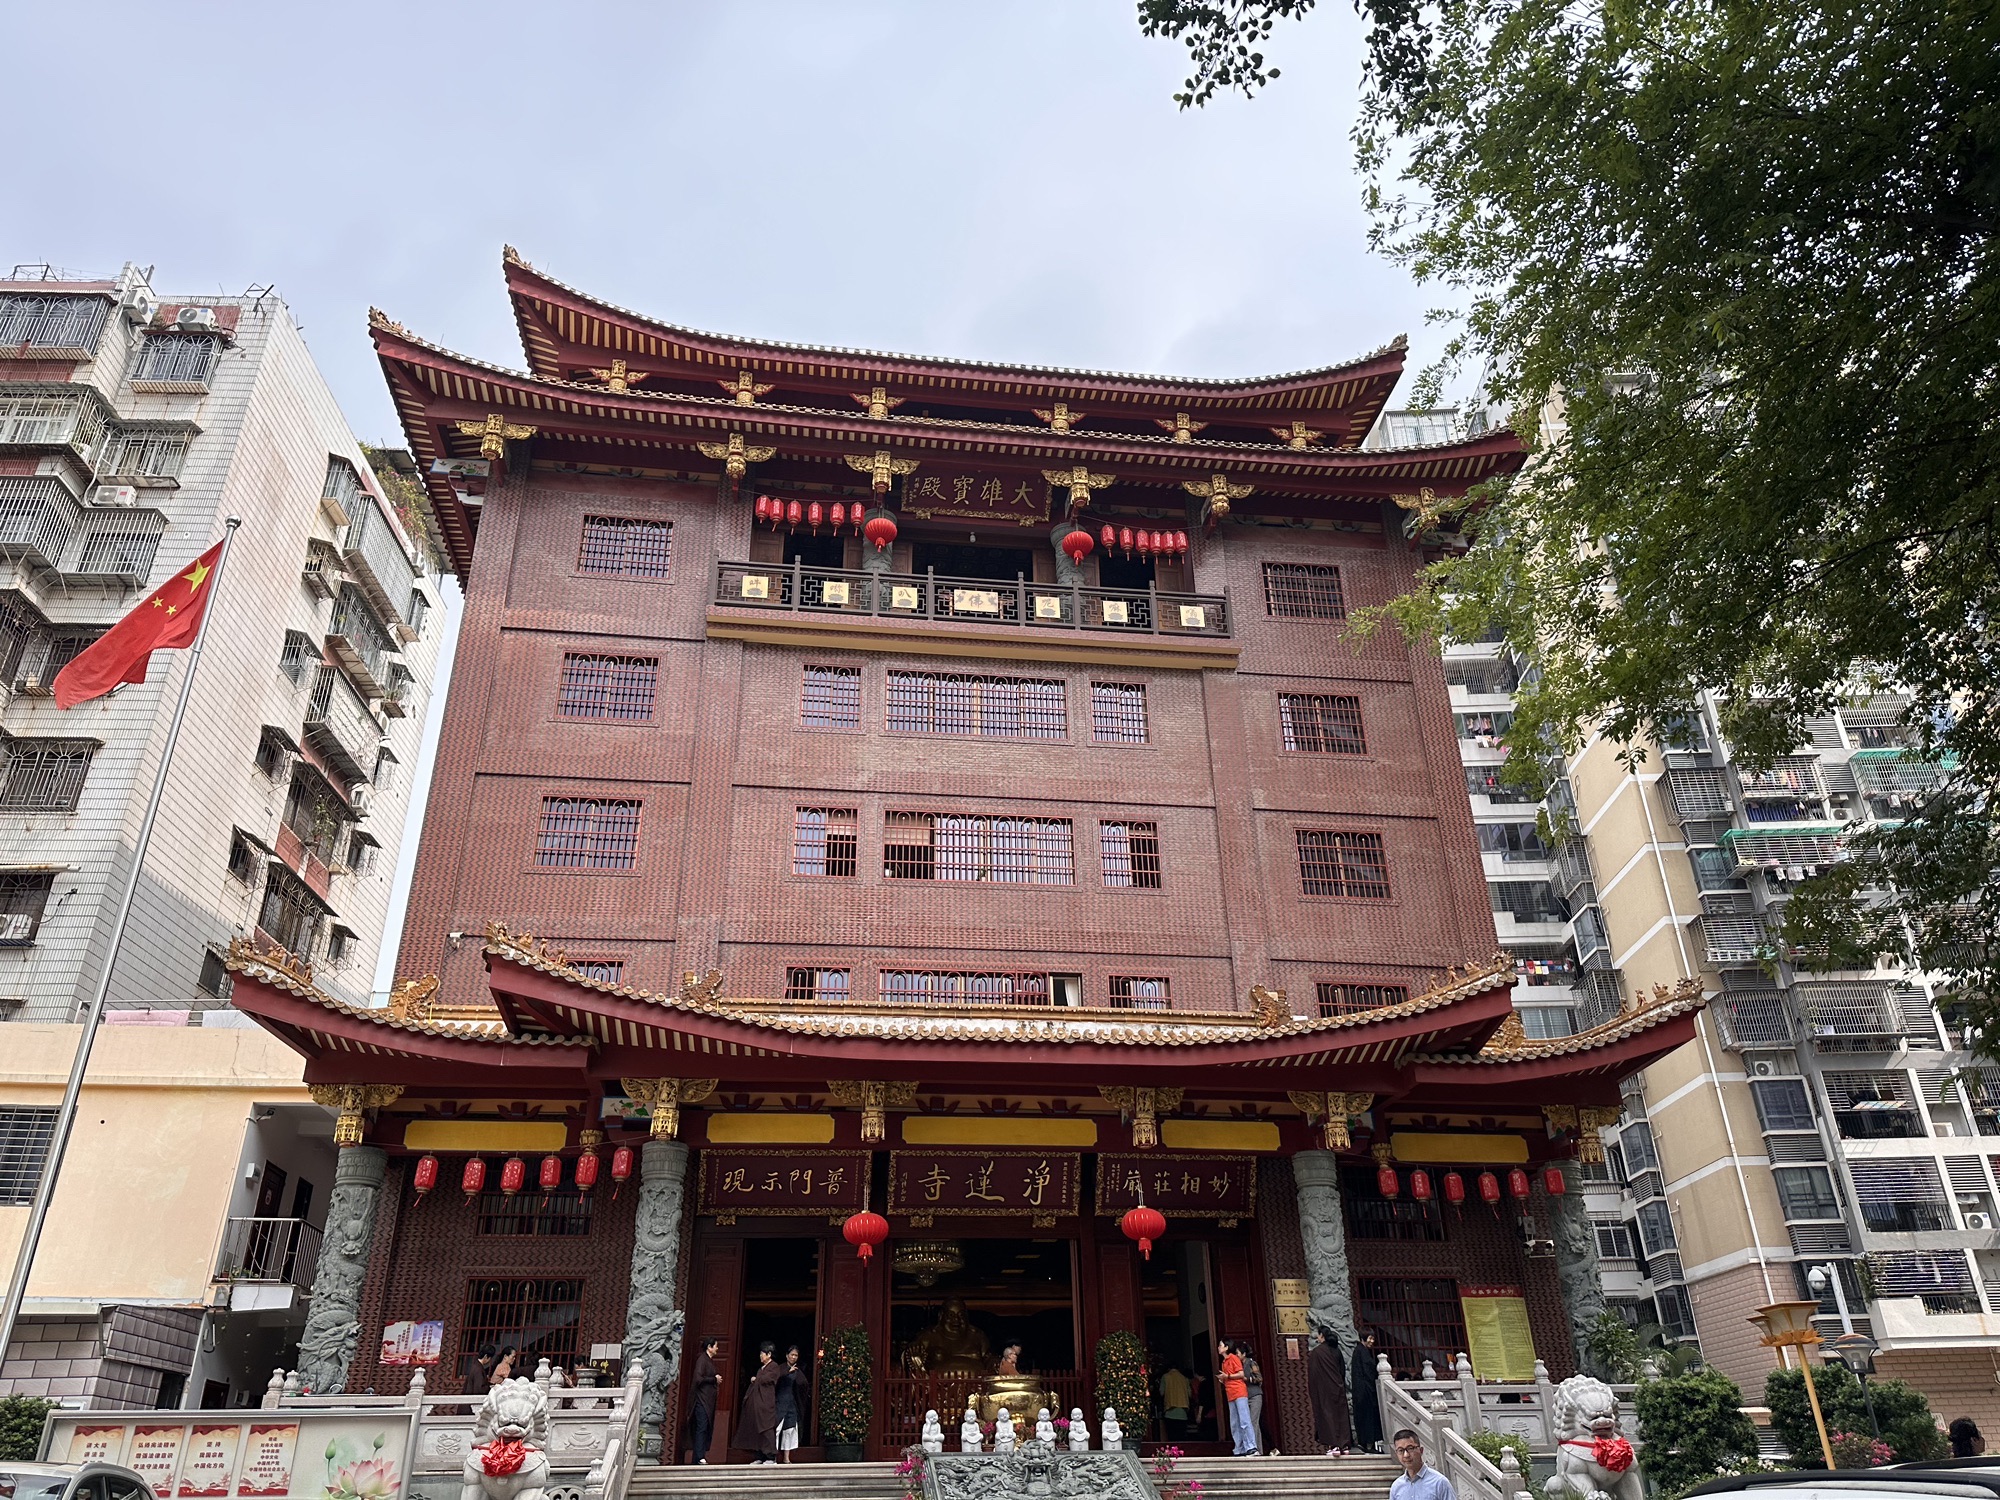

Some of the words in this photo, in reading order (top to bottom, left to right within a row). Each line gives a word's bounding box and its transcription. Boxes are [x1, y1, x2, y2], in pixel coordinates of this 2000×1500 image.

[919, 474, 1036, 510] 大雄寶殿
[968, 593, 984, 609] 佛
[722, 1167, 849, 1195] 普門示現
